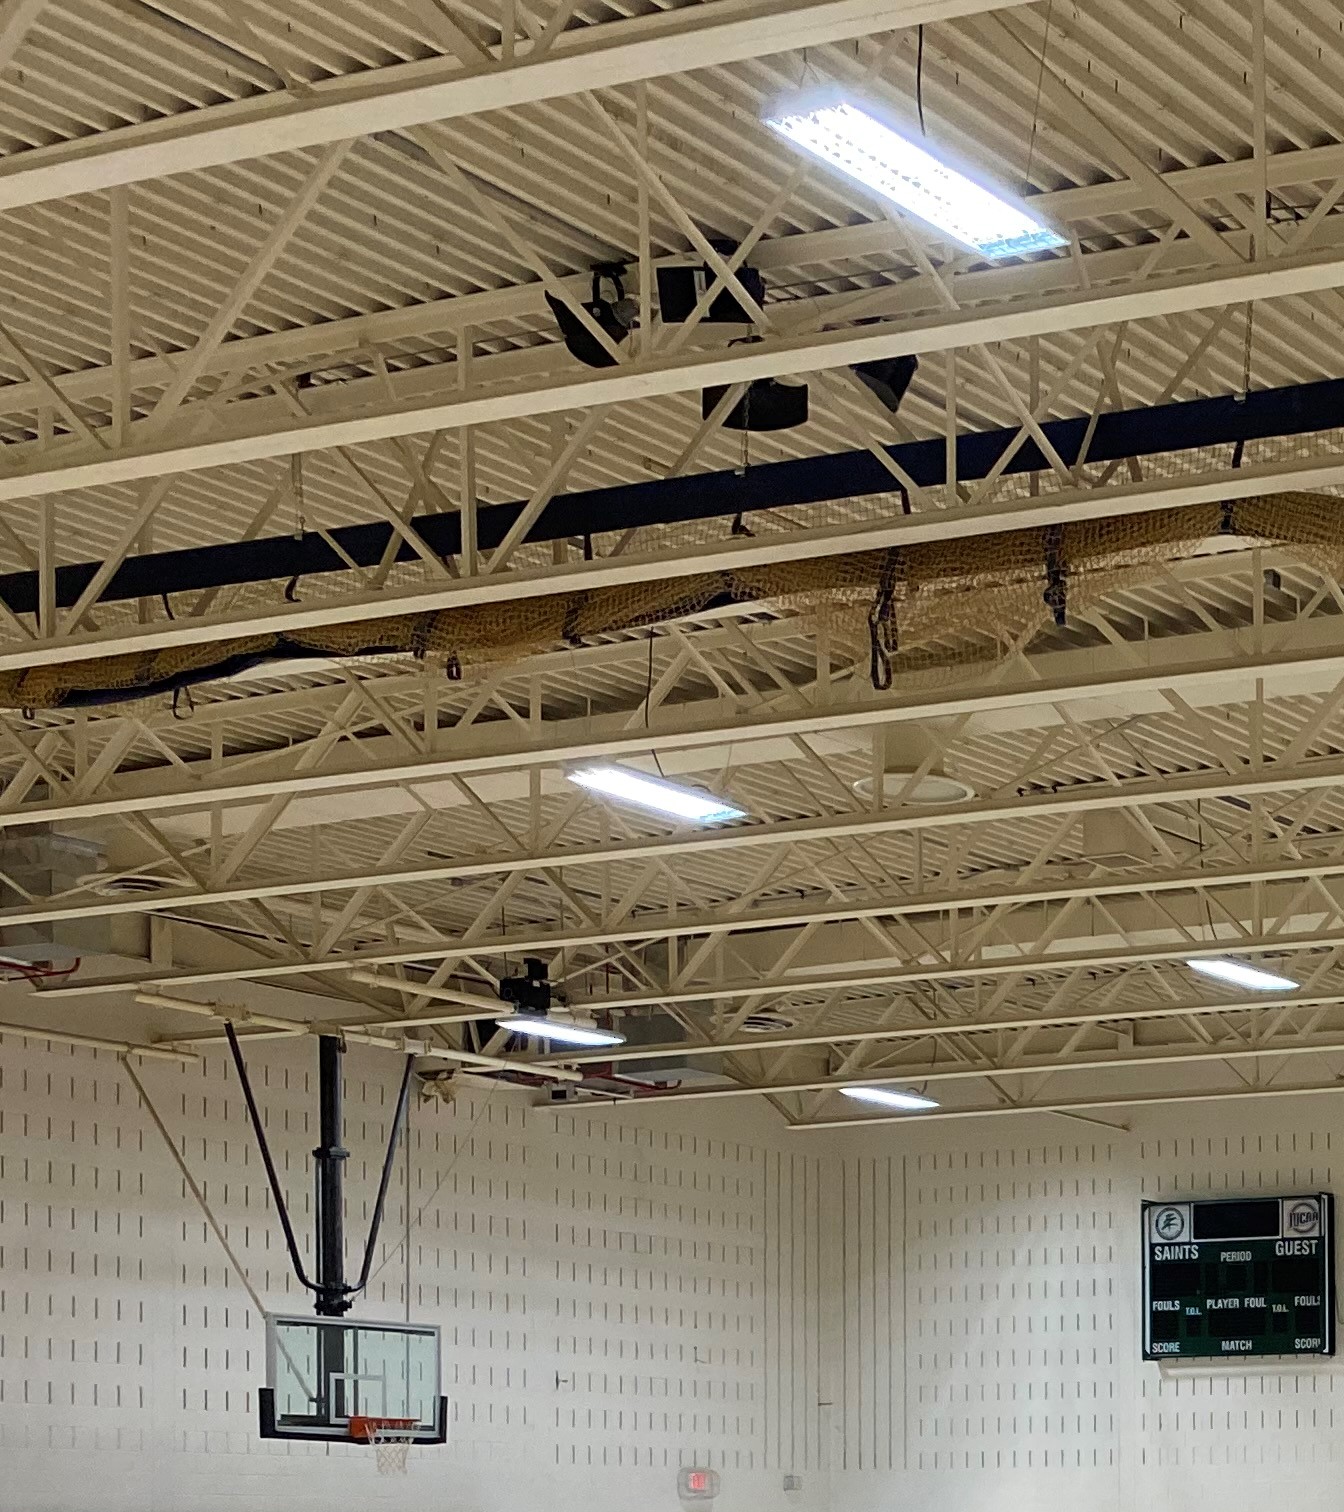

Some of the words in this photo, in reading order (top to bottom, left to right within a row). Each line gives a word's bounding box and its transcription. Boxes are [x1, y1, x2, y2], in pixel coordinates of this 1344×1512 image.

[1155, 1245, 1199, 1260] SAINTS
[1275, 1240, 1318, 1256] GUEST
[1220, 1251, 1252, 1262] PERIOD
[1153, 1300, 1180, 1311] FOULS
[1207, 1298, 1239, 1309] PLAYER
[1244, 1297, 1266, 1307] FOUL
[1152, 1342, 1180, 1353] SCORE
[1222, 1340, 1252, 1351] MATCH
